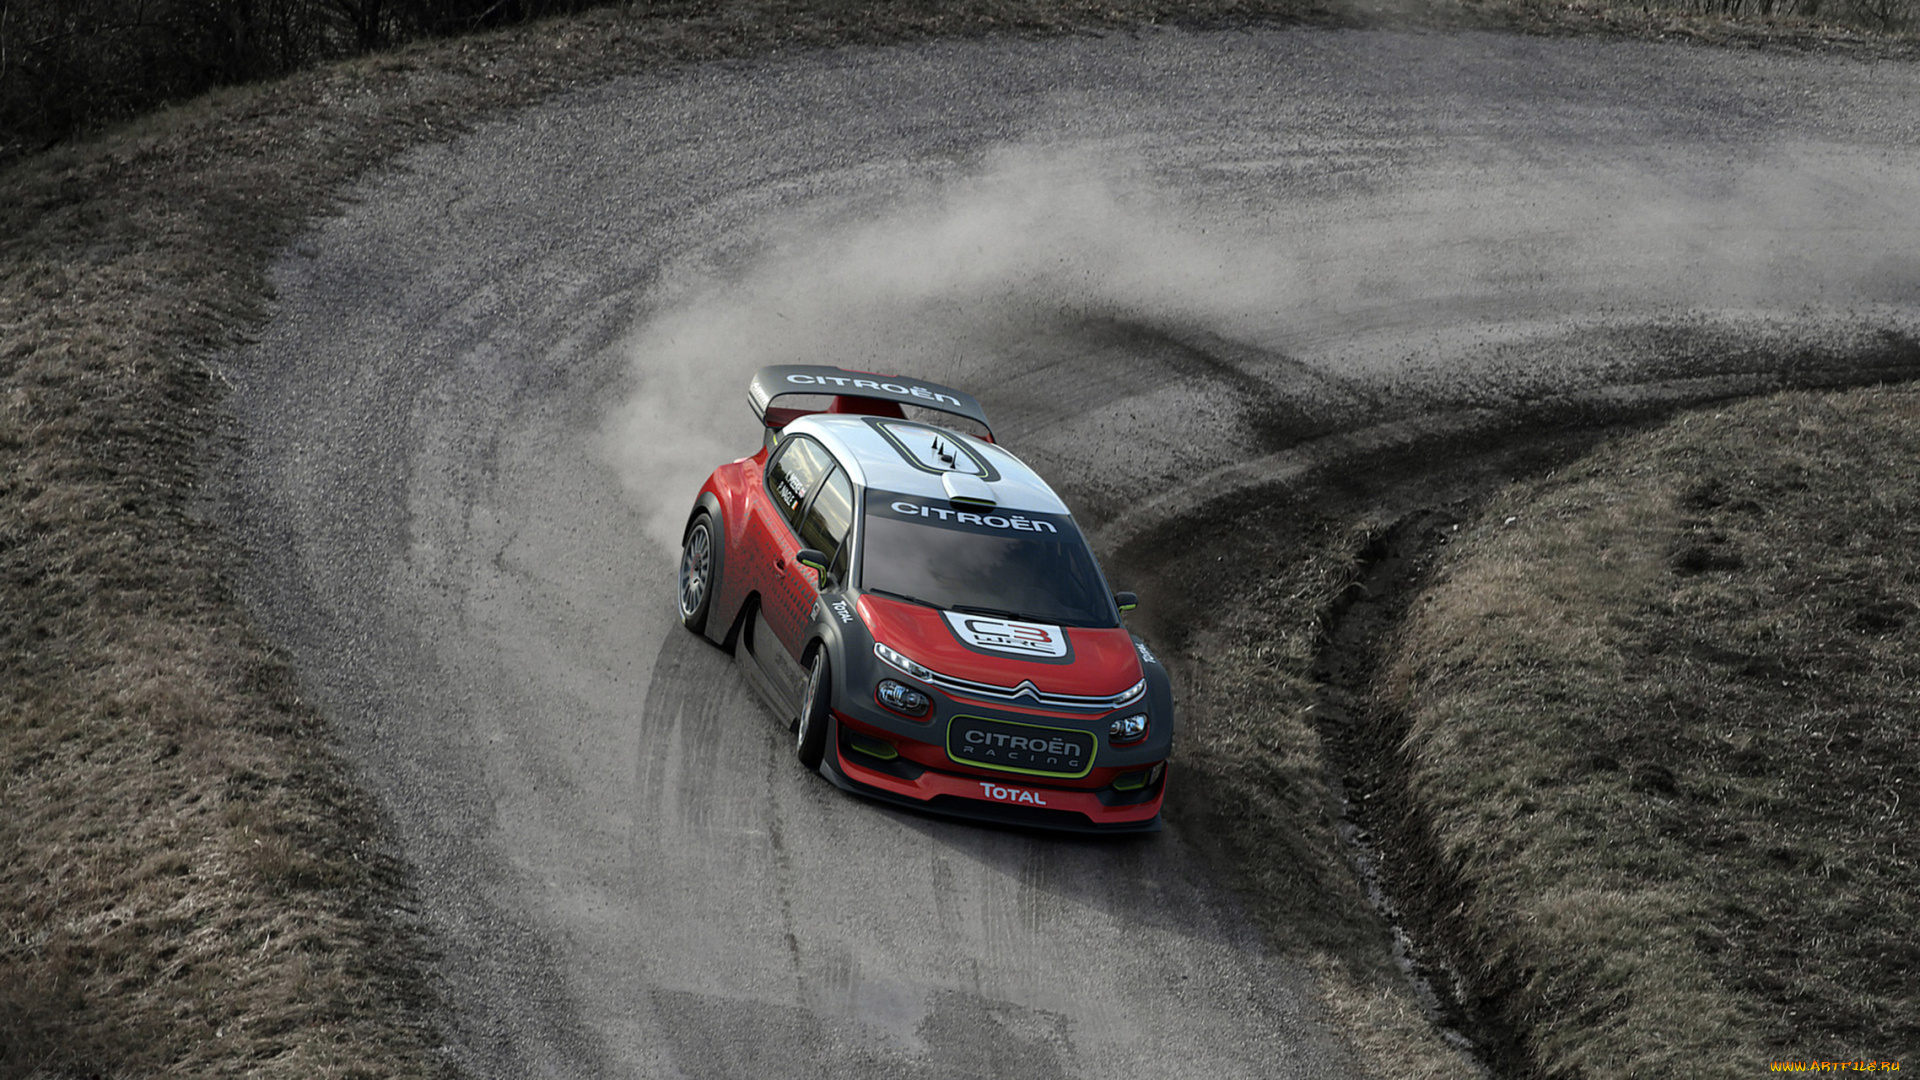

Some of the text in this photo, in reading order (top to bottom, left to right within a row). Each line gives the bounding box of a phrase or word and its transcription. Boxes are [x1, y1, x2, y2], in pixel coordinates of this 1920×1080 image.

[787, 375, 961, 407] CITROËN
[891, 502, 1058, 533] CITROËN
[832, 600, 853, 623] TOTAL
[964, 619, 1053, 643] C3
[965, 730, 1081, 757] CITROËN
[963, 746, 1080, 768] RACING
[979, 782, 1047, 806] TOTAL
